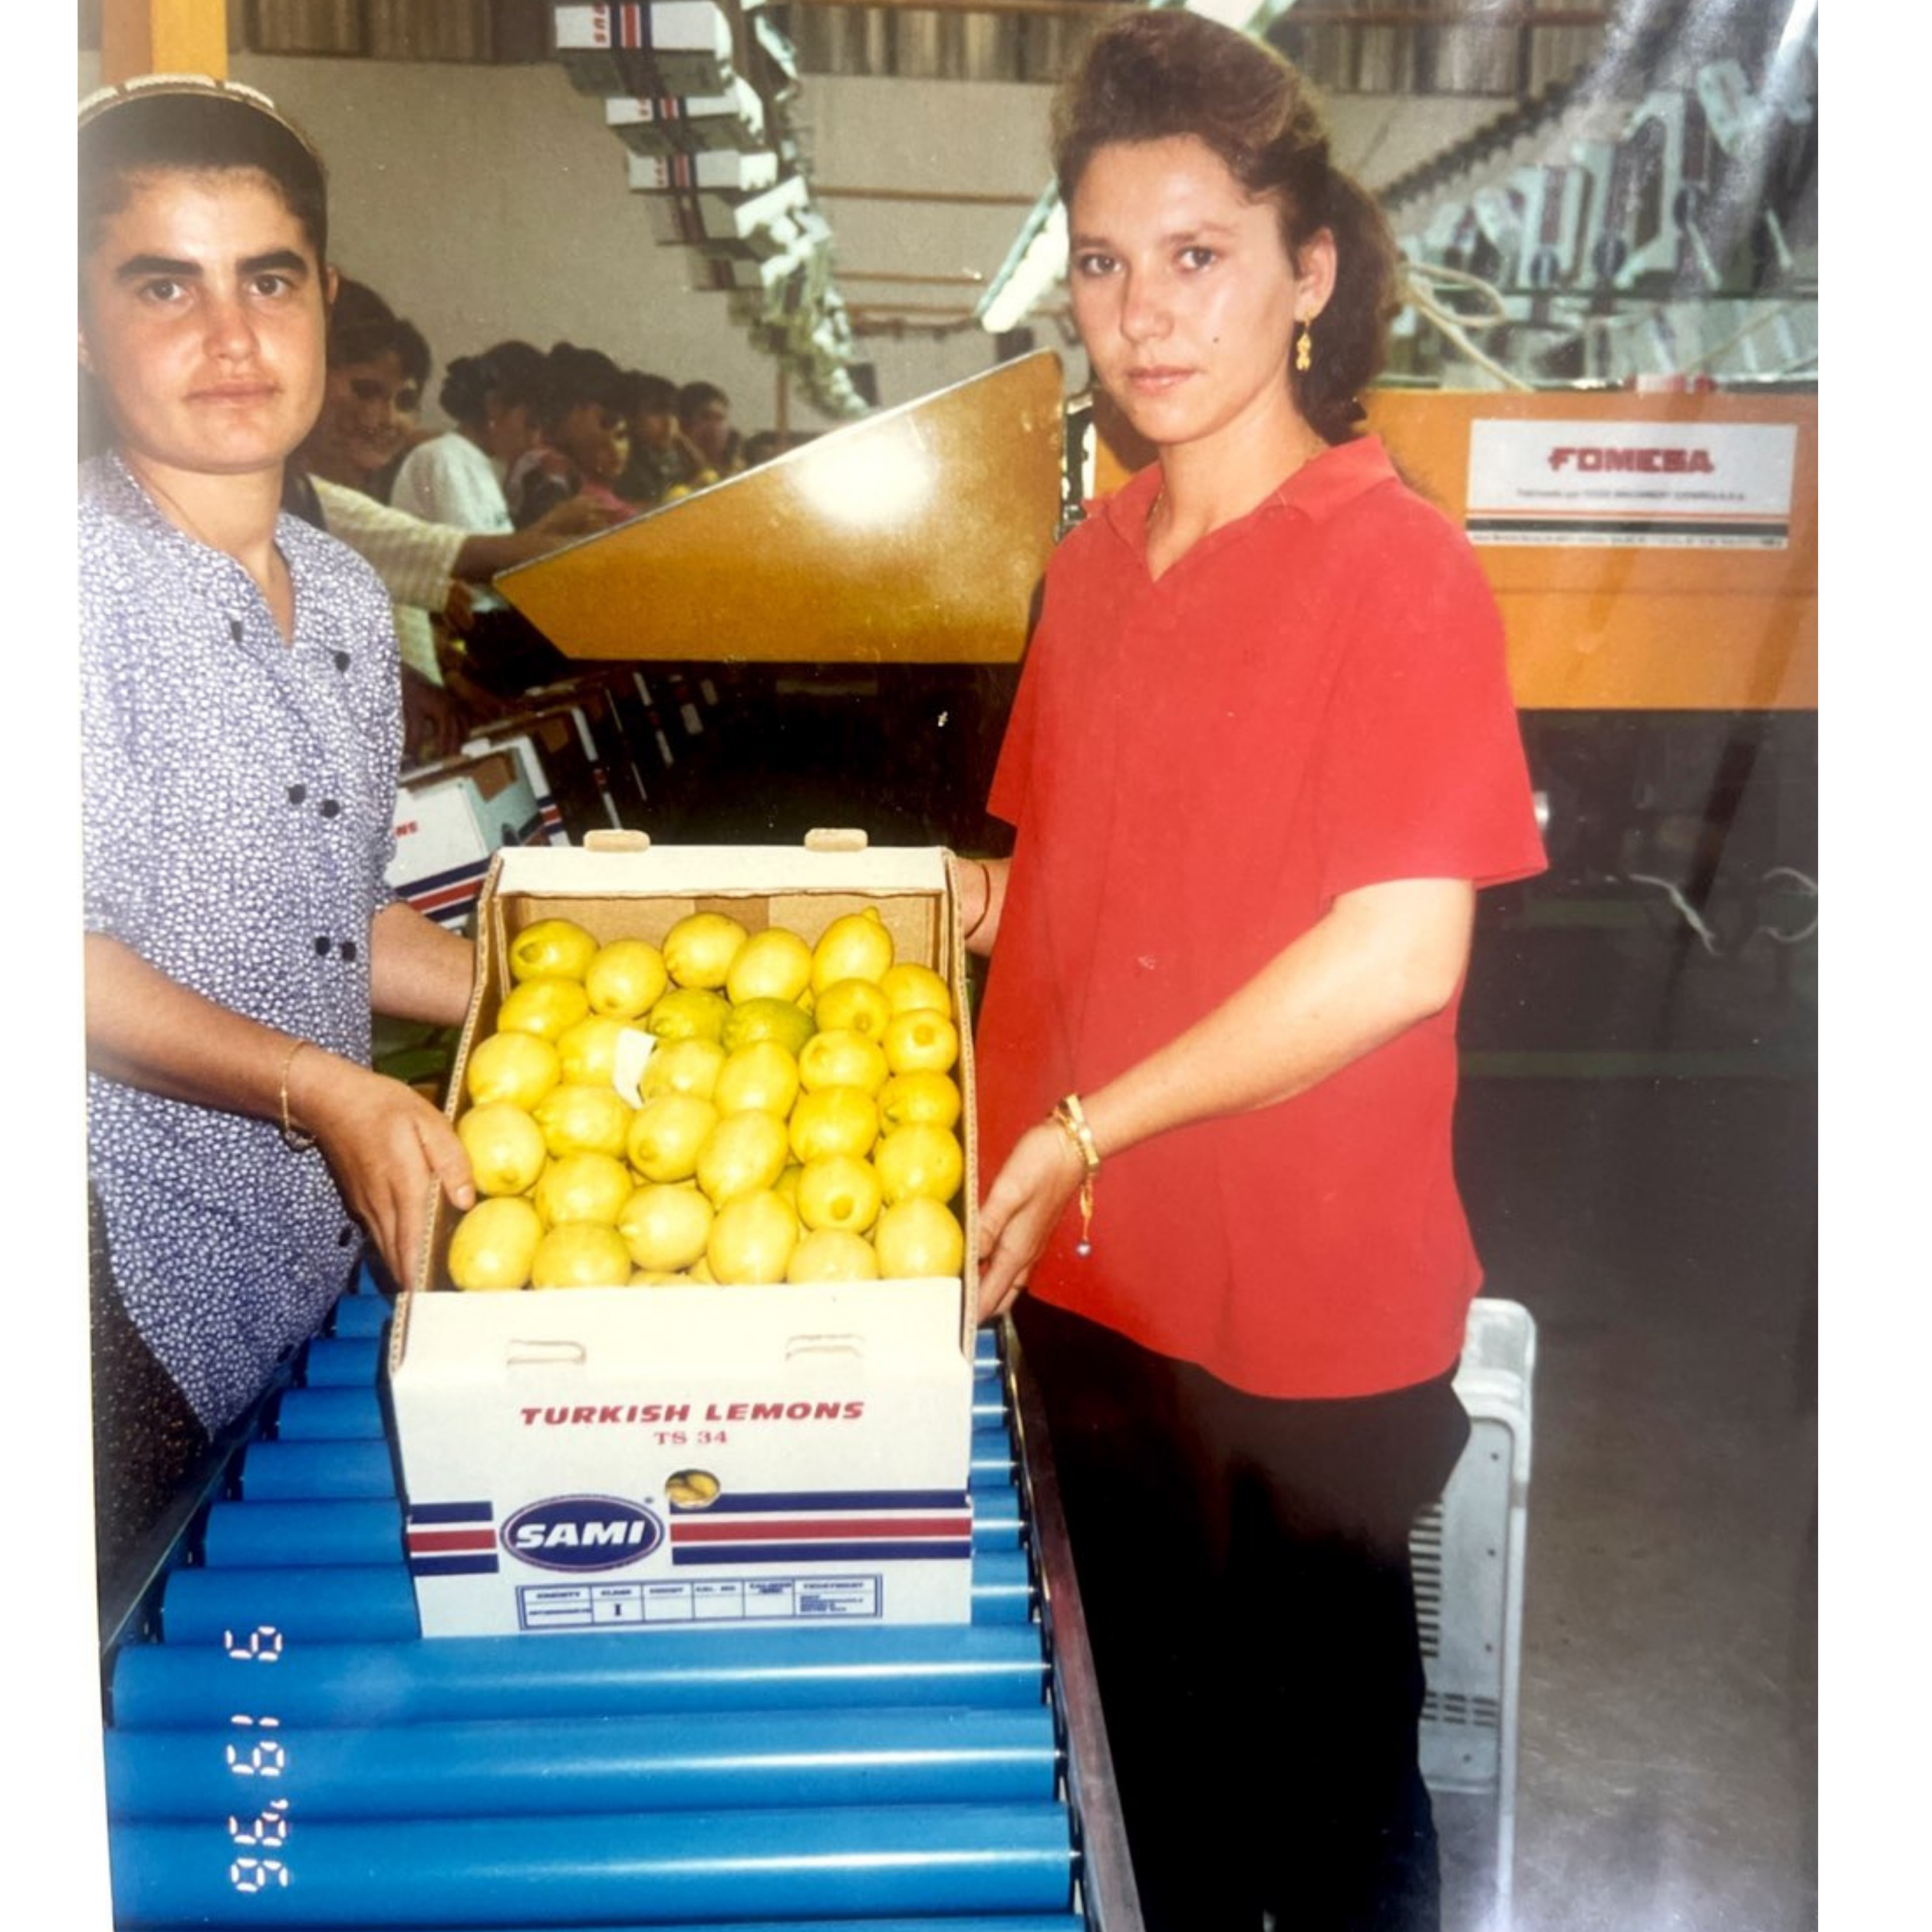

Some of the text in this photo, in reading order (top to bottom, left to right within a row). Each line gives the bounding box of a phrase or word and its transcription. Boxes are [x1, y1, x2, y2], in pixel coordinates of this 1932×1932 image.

[520, 1401, 864, 1425] TURKISH LEMONS
[654, 1430, 728, 1445] TS 34
[515, 1519, 646, 1549] SAMI
